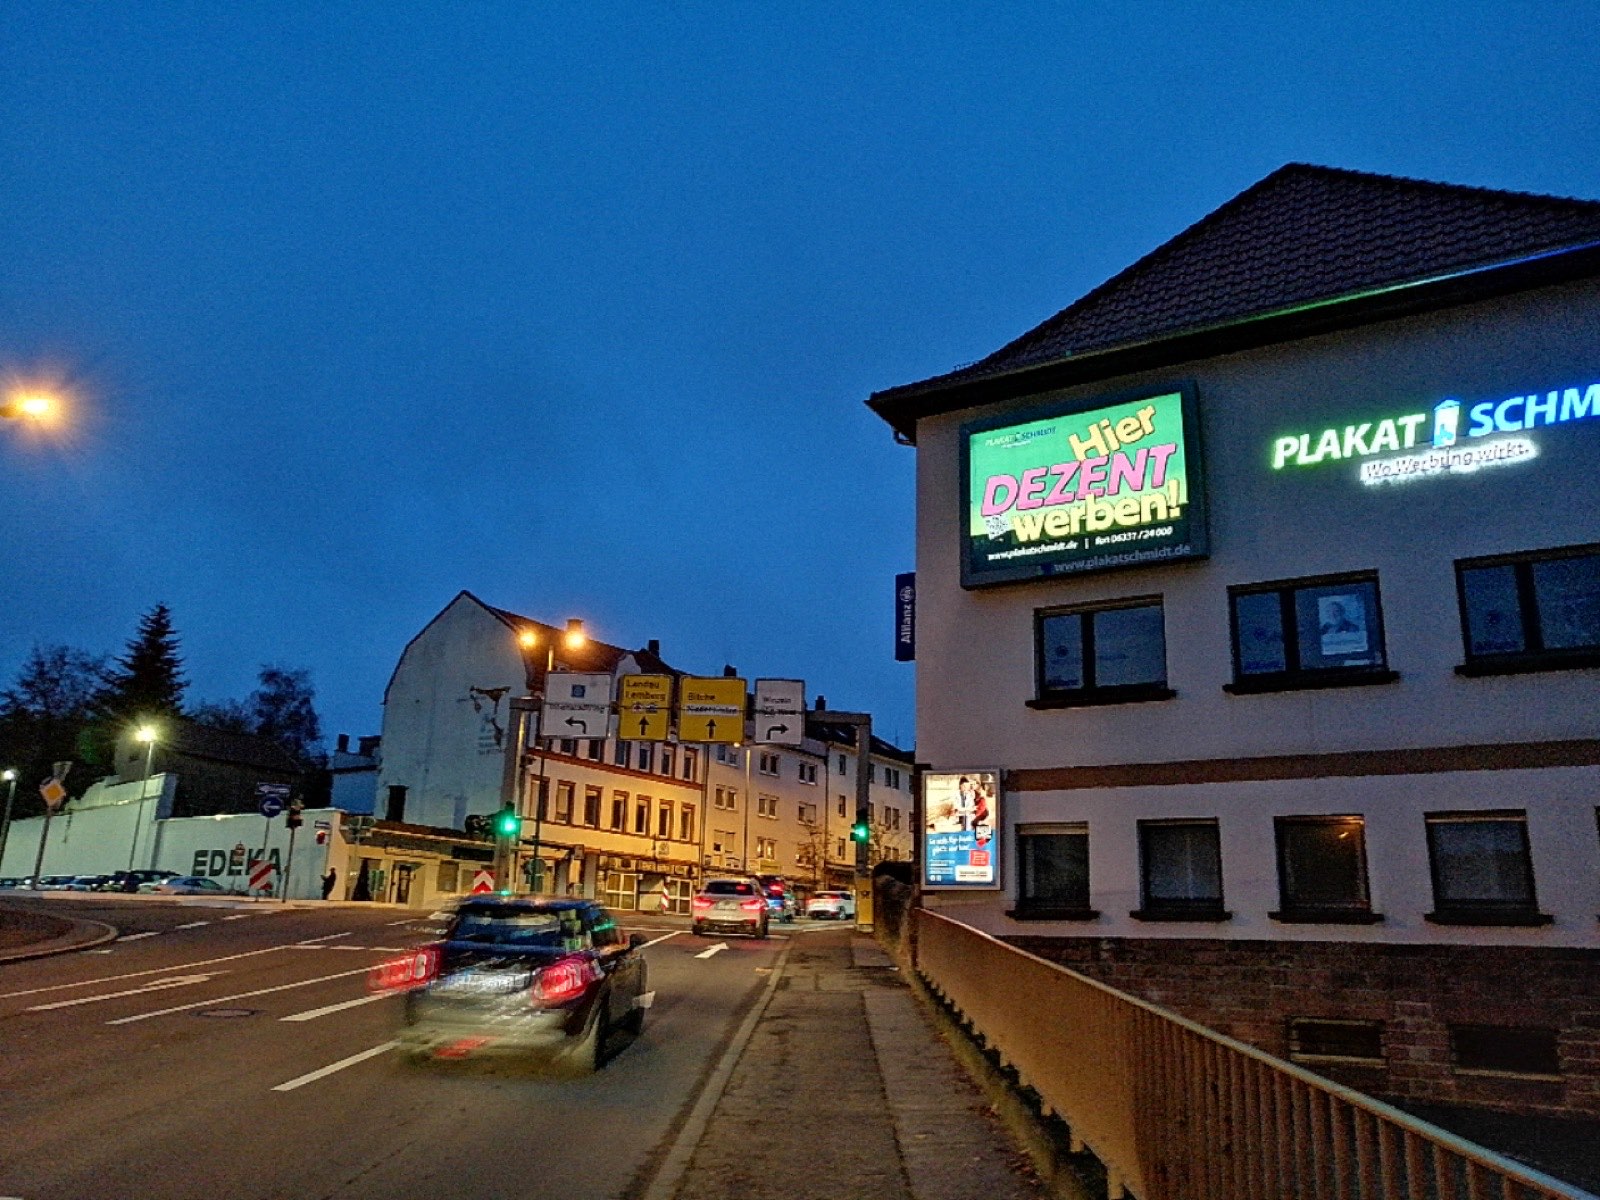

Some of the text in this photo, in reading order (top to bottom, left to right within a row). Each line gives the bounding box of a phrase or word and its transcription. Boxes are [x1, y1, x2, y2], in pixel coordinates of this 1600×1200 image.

[1069, 405, 1156, 461] Hier
[1272, 413, 1426, 470] PLAKAT
[981, 444, 1178, 516] DEZENT
[1013, 480, 1180, 542] werben!
[1053, 545, 1191, 574] www.plakatschmidt.de
[901, 604, 911, 643] Allianz
[191, 848, 281, 876] EDEKA
